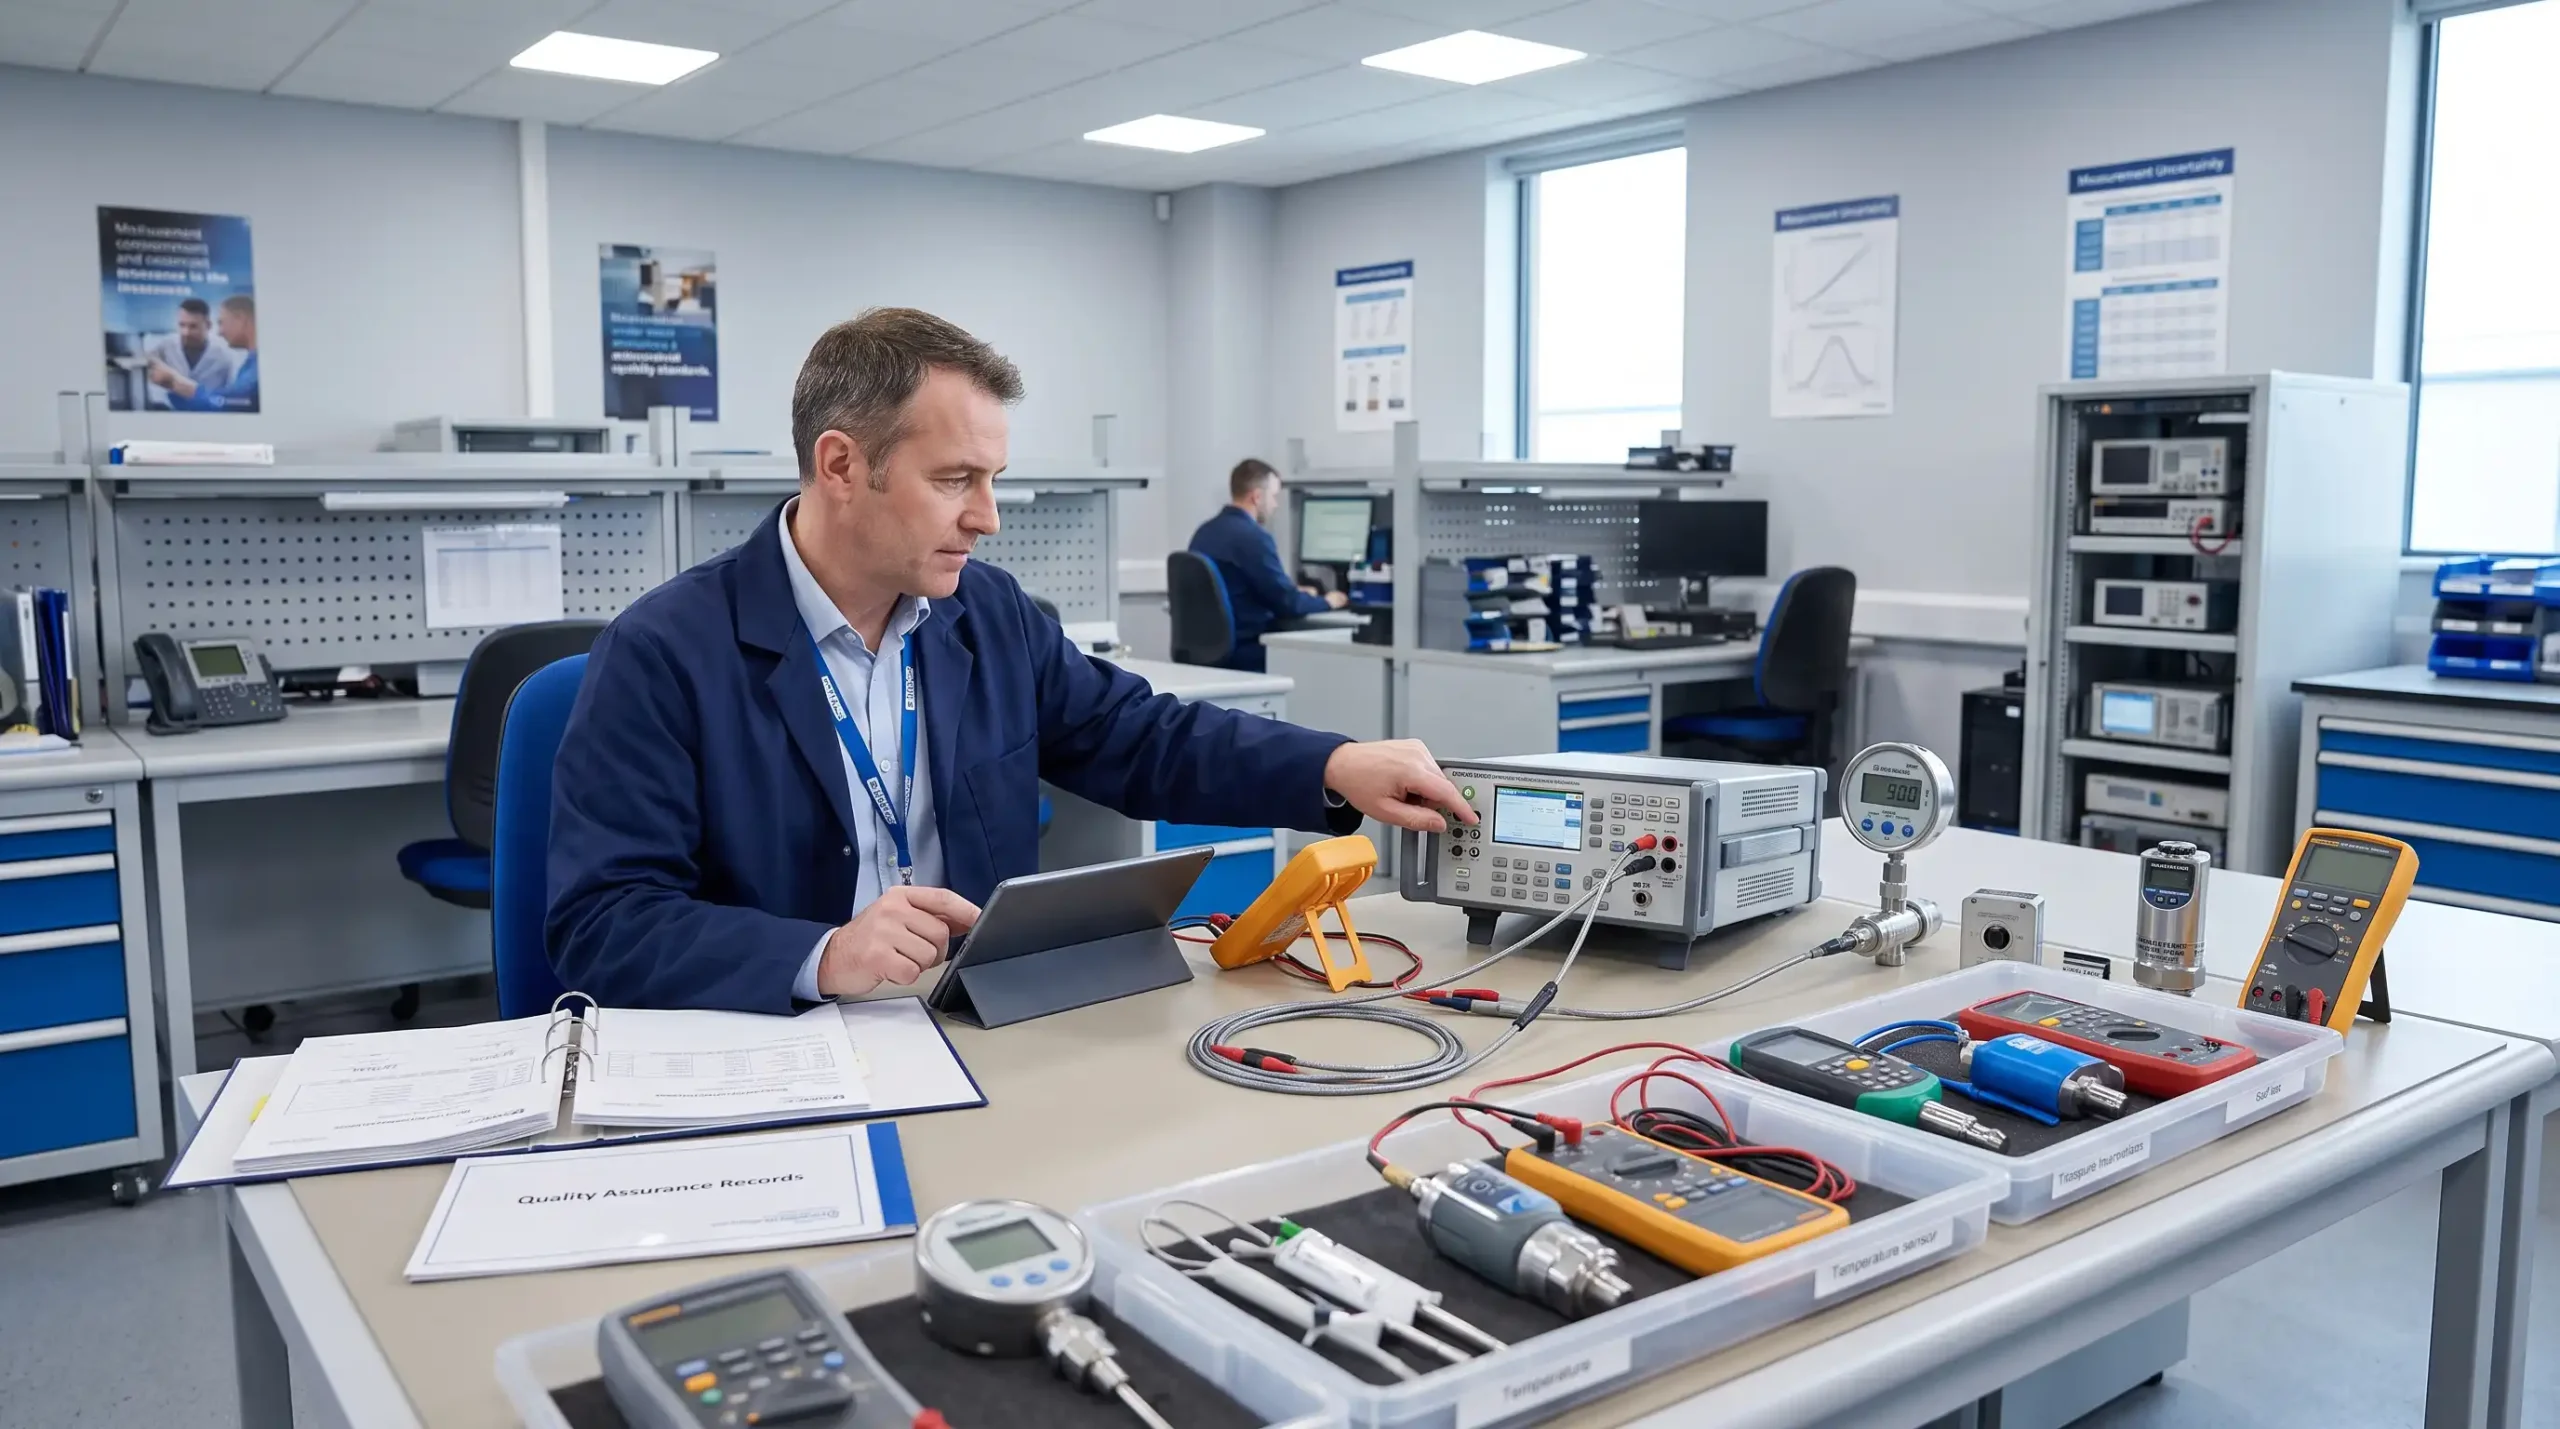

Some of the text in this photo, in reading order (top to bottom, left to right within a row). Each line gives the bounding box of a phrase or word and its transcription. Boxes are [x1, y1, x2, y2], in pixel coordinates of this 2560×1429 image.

[518, 1173, 805, 1205] Quality Assurance Records
